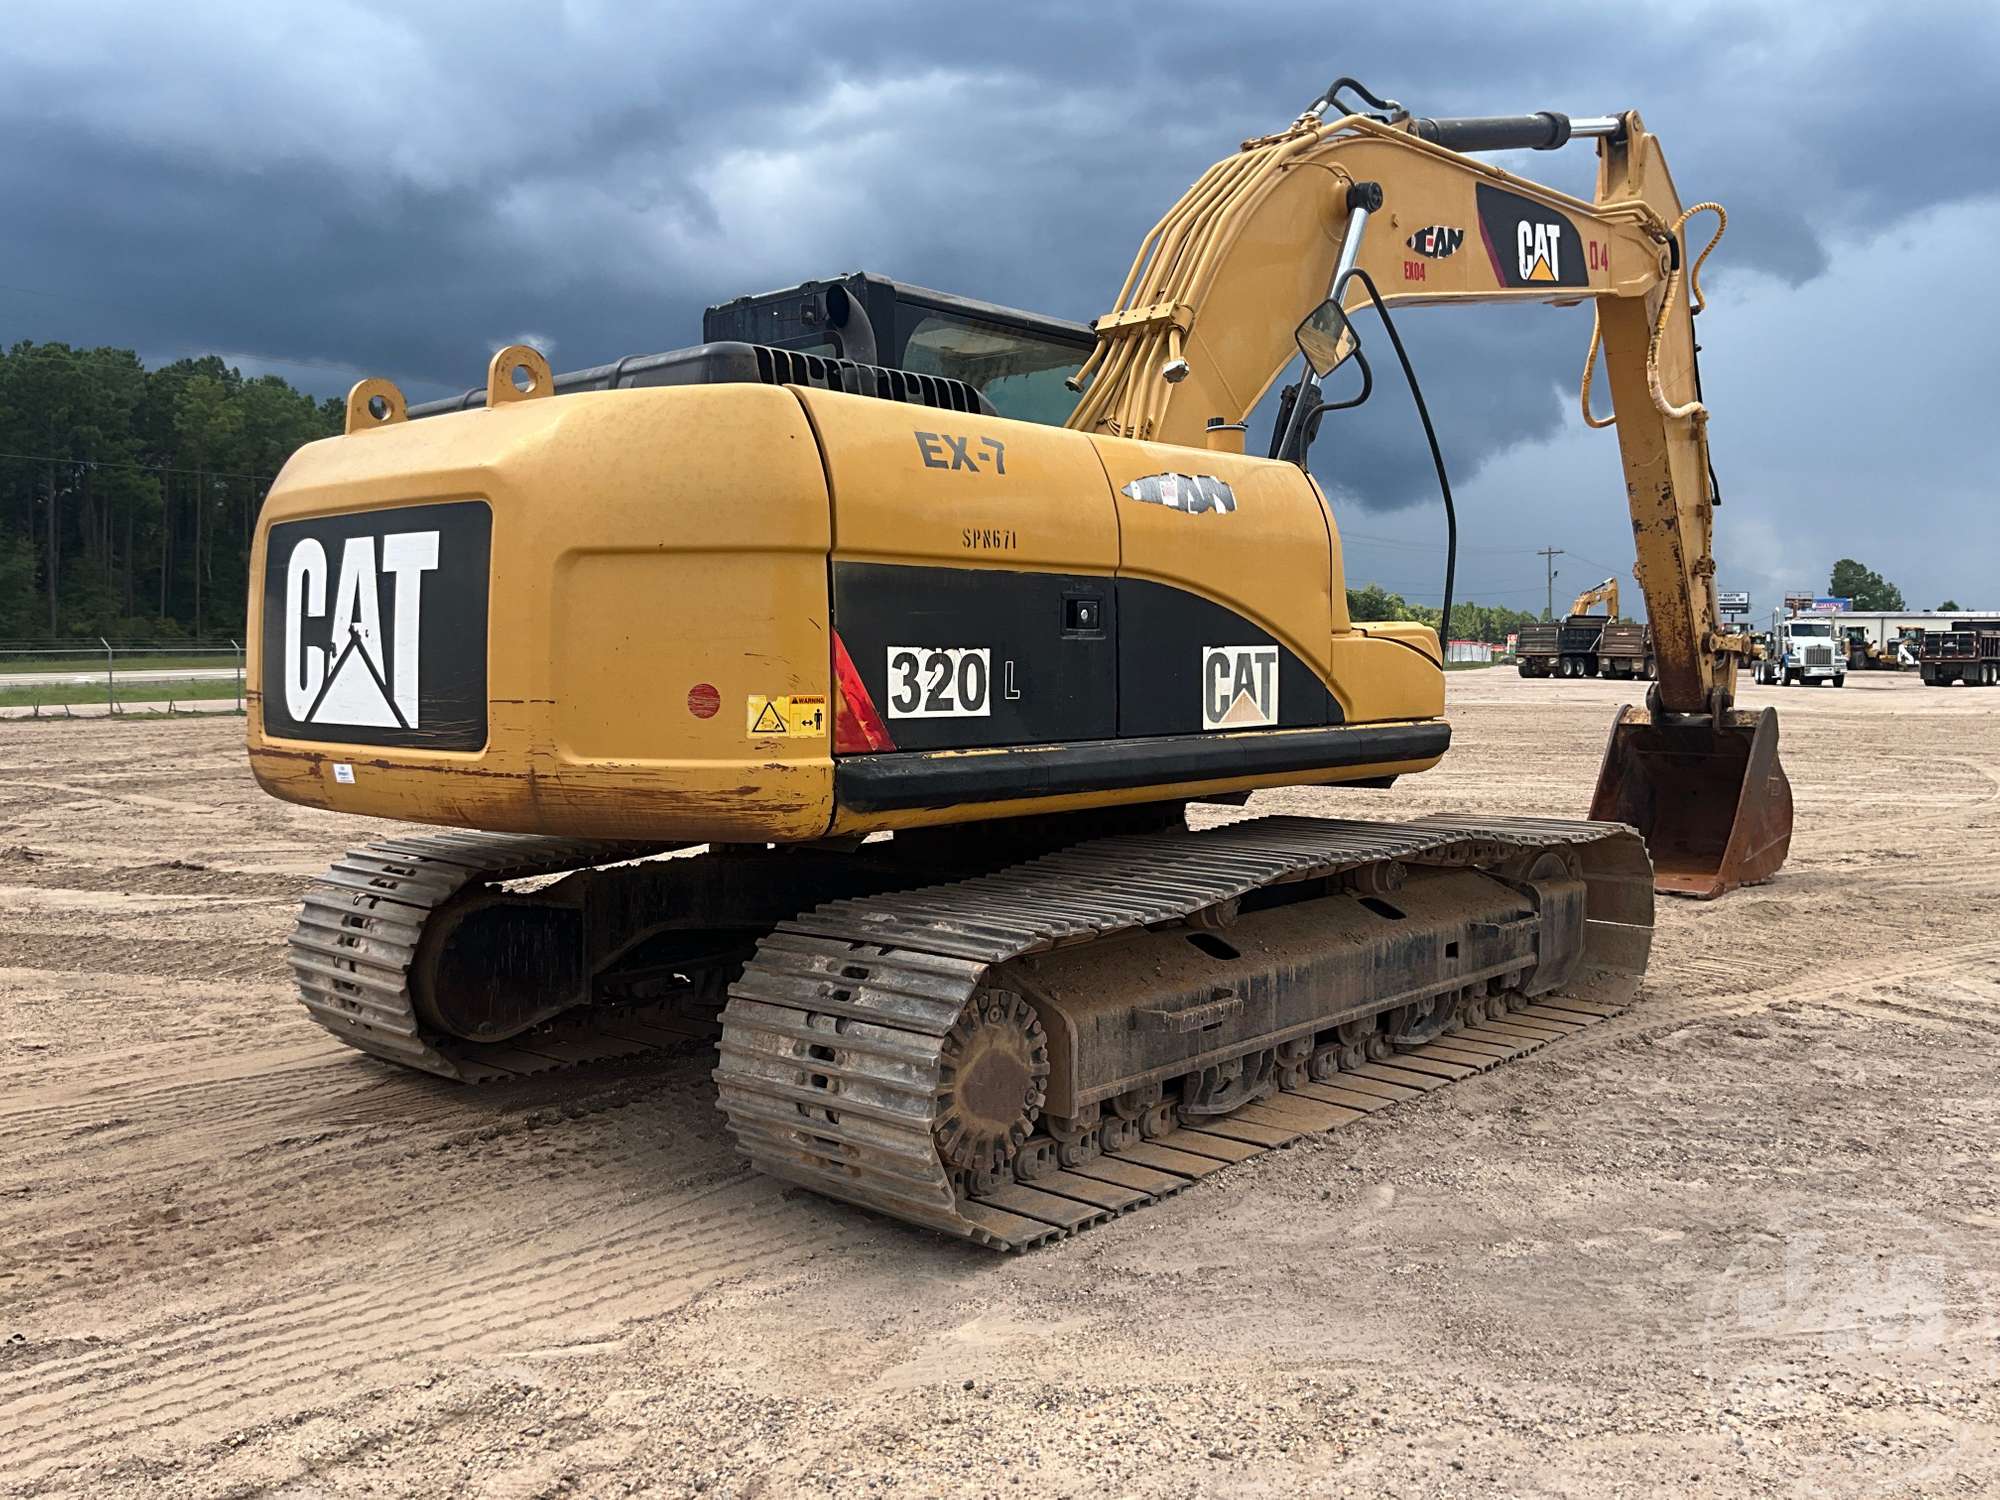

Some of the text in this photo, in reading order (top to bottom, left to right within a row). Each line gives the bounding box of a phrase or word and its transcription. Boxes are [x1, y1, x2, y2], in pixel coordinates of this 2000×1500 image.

[1517, 220, 1560, 281] CAT
[914, 431, 1006, 475] EX-7
[962, 528, 1017, 550] SPN671
[285, 531, 440, 730] CAT
[798, 697, 825, 705] WARNING
[892, 651, 1021, 714] 320 L
[1206, 651, 1277, 723] CAT
